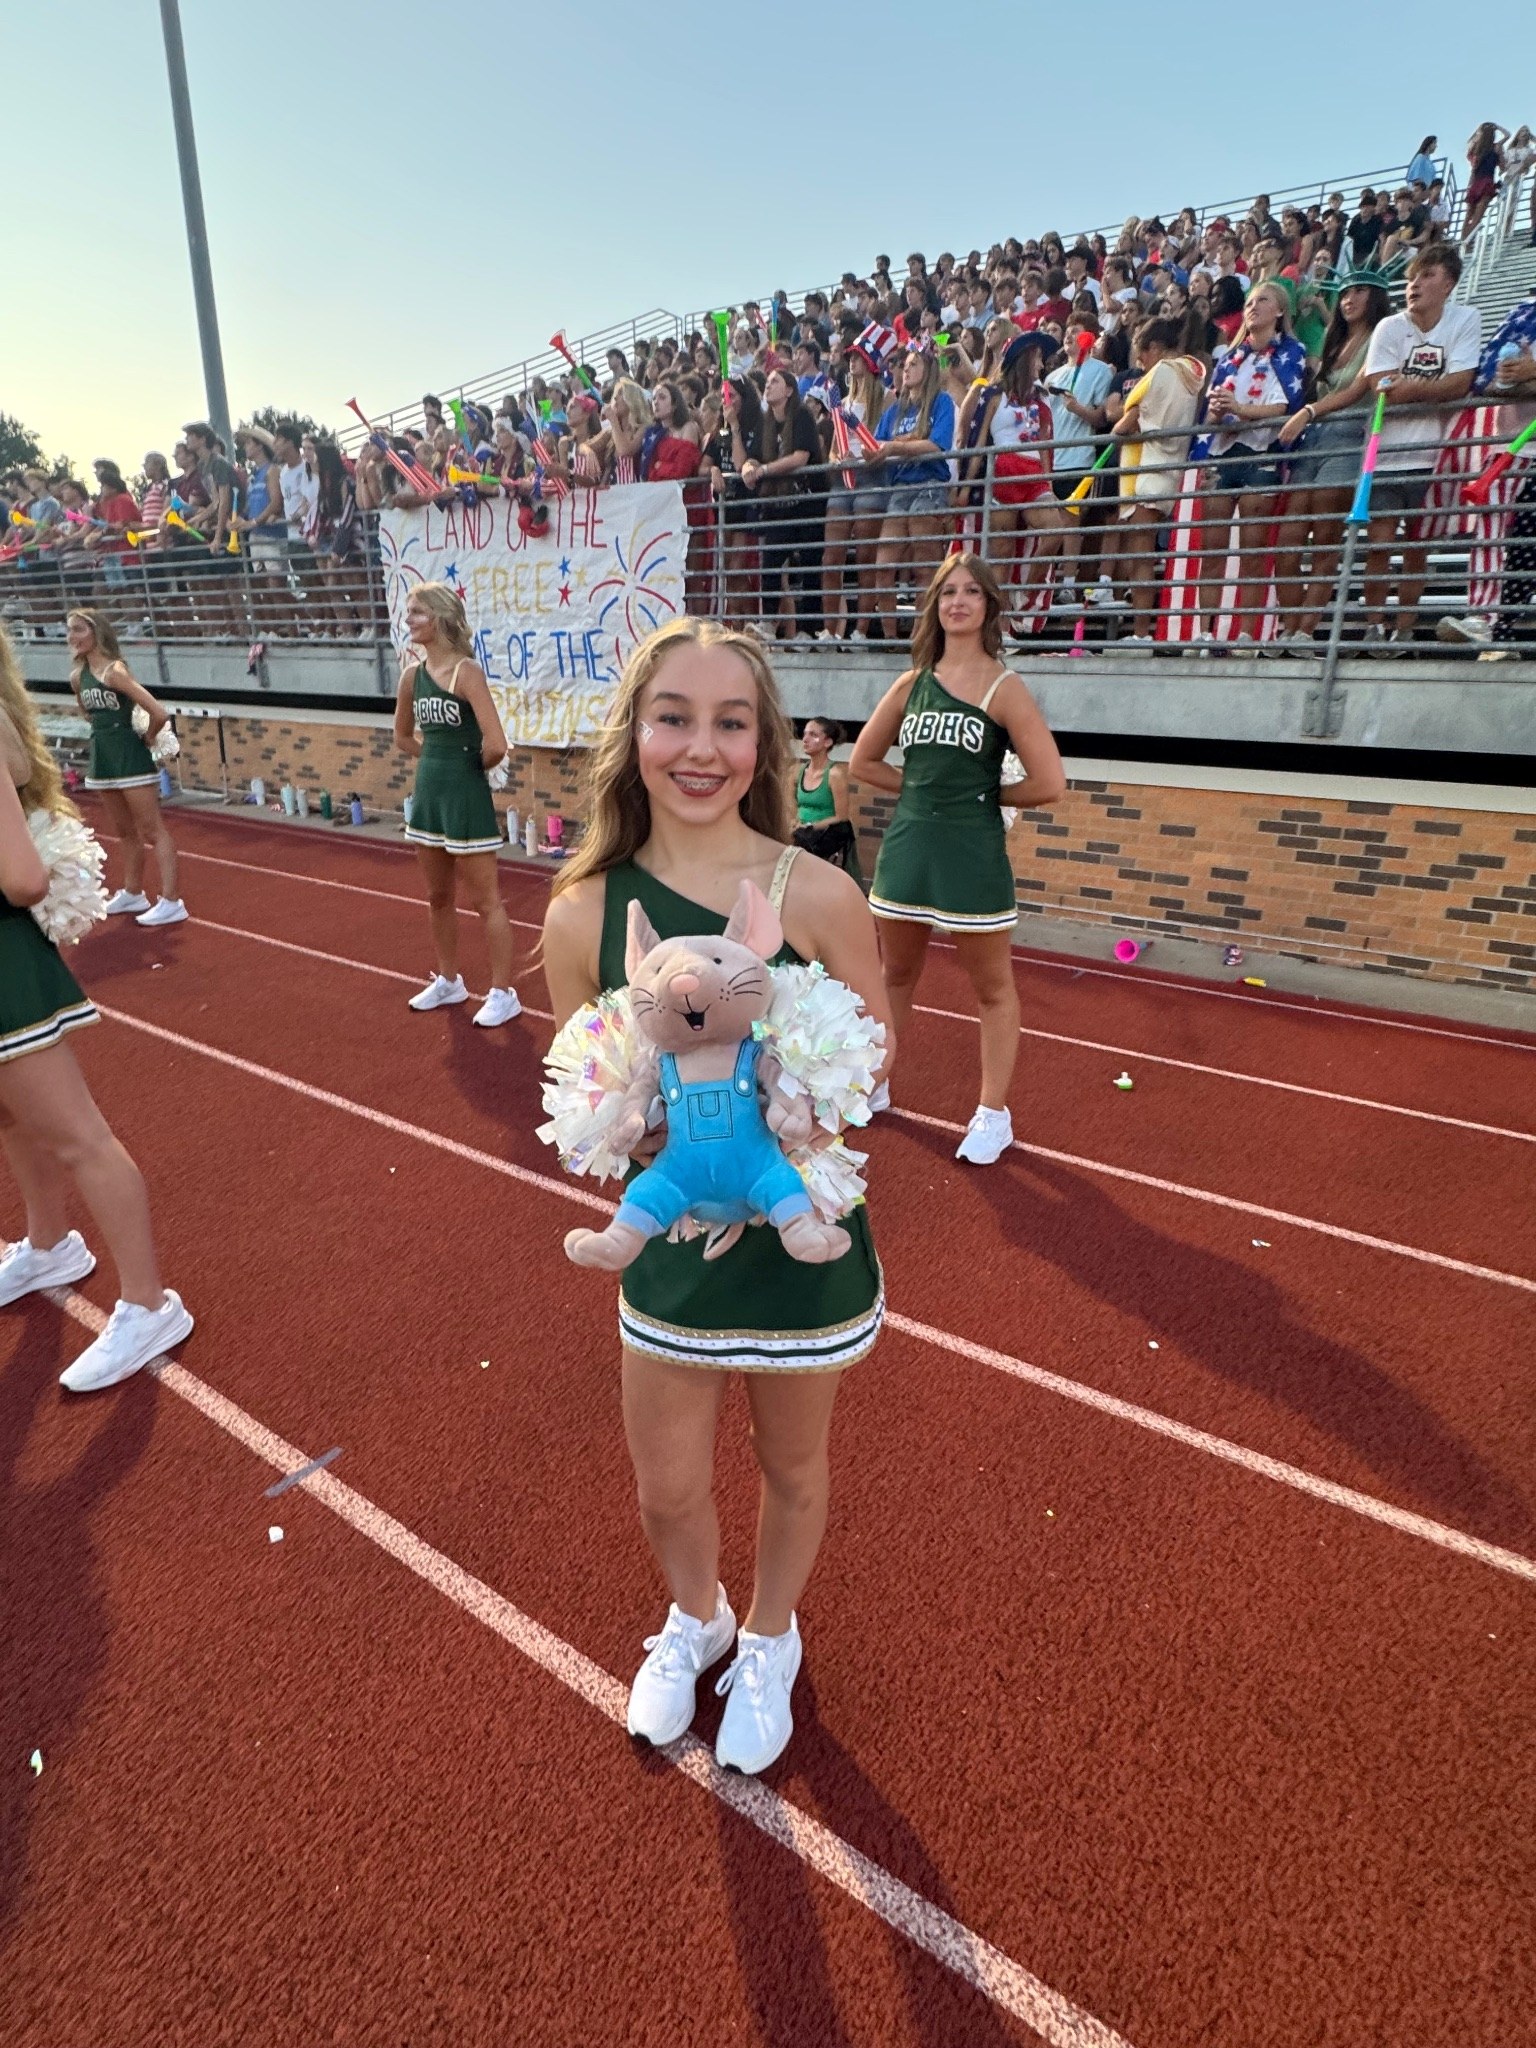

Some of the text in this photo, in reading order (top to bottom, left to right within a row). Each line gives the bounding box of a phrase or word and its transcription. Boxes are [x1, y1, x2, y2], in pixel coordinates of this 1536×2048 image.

[427, 498, 494, 552] LAND
[551, 488, 608, 549] THE
[472, 561, 554, 615] FREE
[507, 631, 537, 681] OF
[549, 628, 610, 683] THE
[899, 711, 985, 754] RBHS
